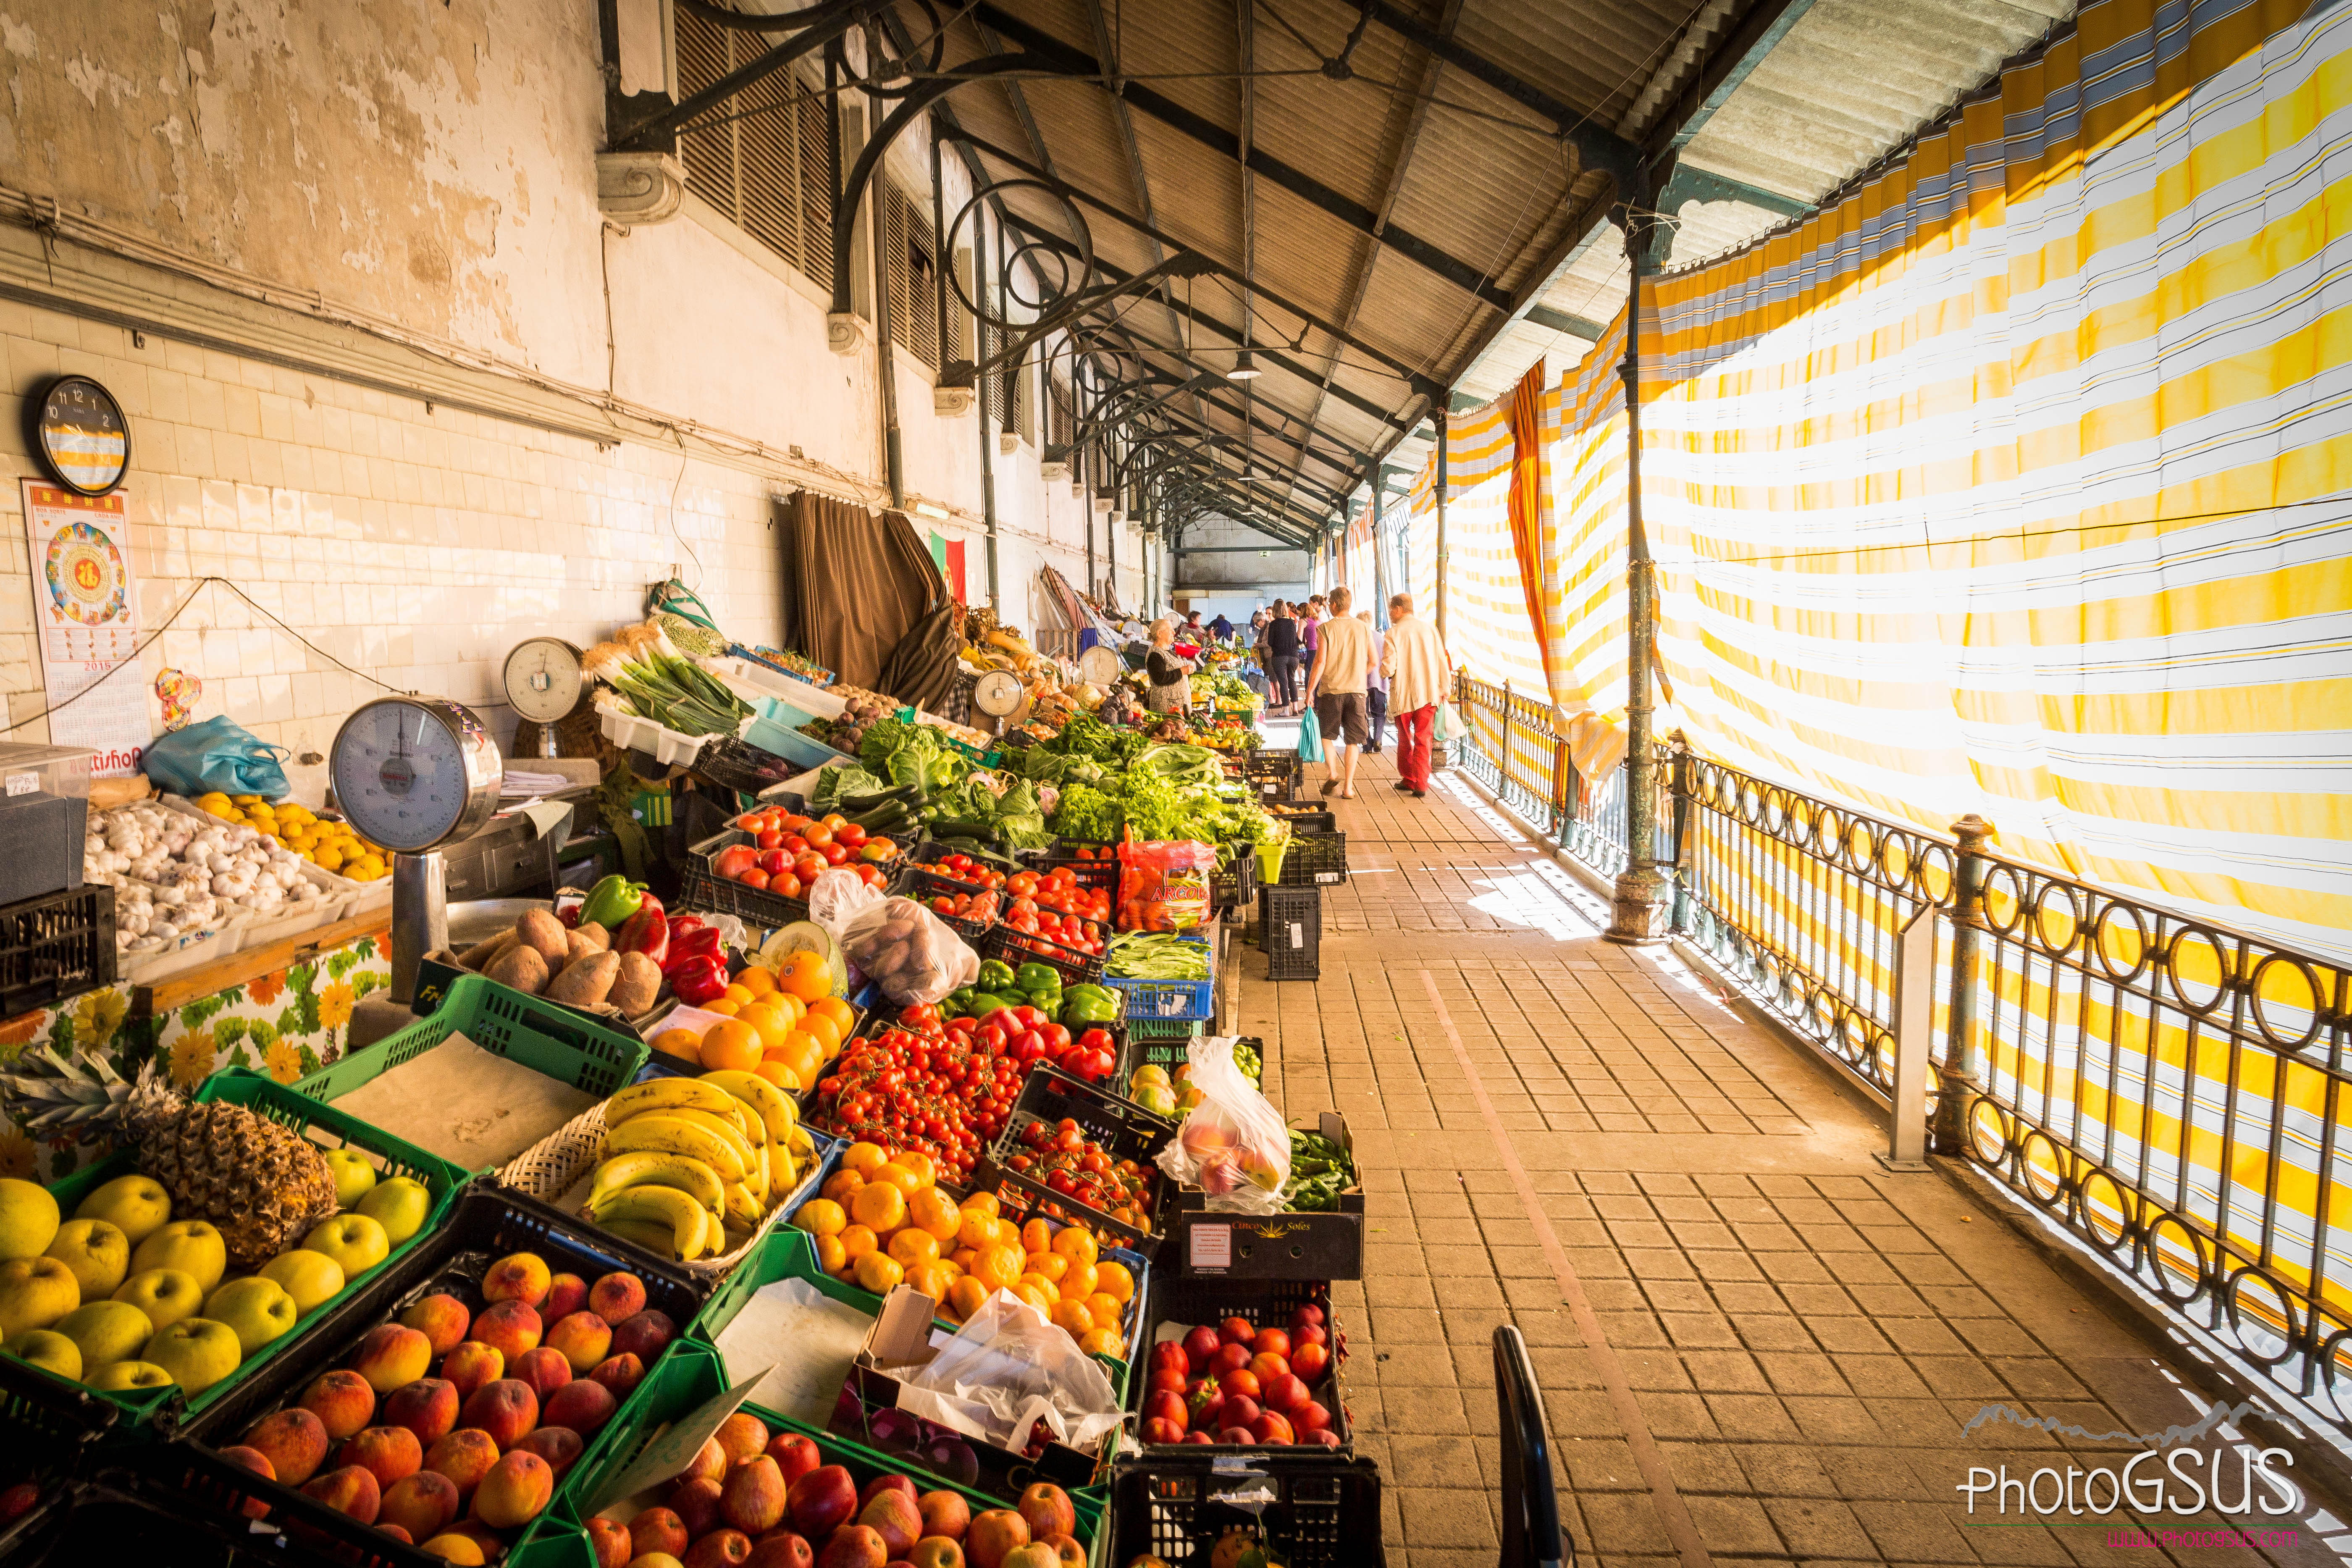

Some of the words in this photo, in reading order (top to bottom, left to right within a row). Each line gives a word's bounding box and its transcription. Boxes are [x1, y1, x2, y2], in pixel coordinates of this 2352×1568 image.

[59, 390, 68, 405] 11
[73, 388, 84, 403] 12
[92, 398, 96, 410] 1
[48, 404, 58, 419] 10
[103, 414, 110, 428] 2
[52, 448, 58, 460] 8
[81, 472, 87, 482] 6
[84, 662, 111, 671] 2015
[1232, 1220, 1260, 1229] Cinco
[1286, 1221, 1310, 1230] Soles
